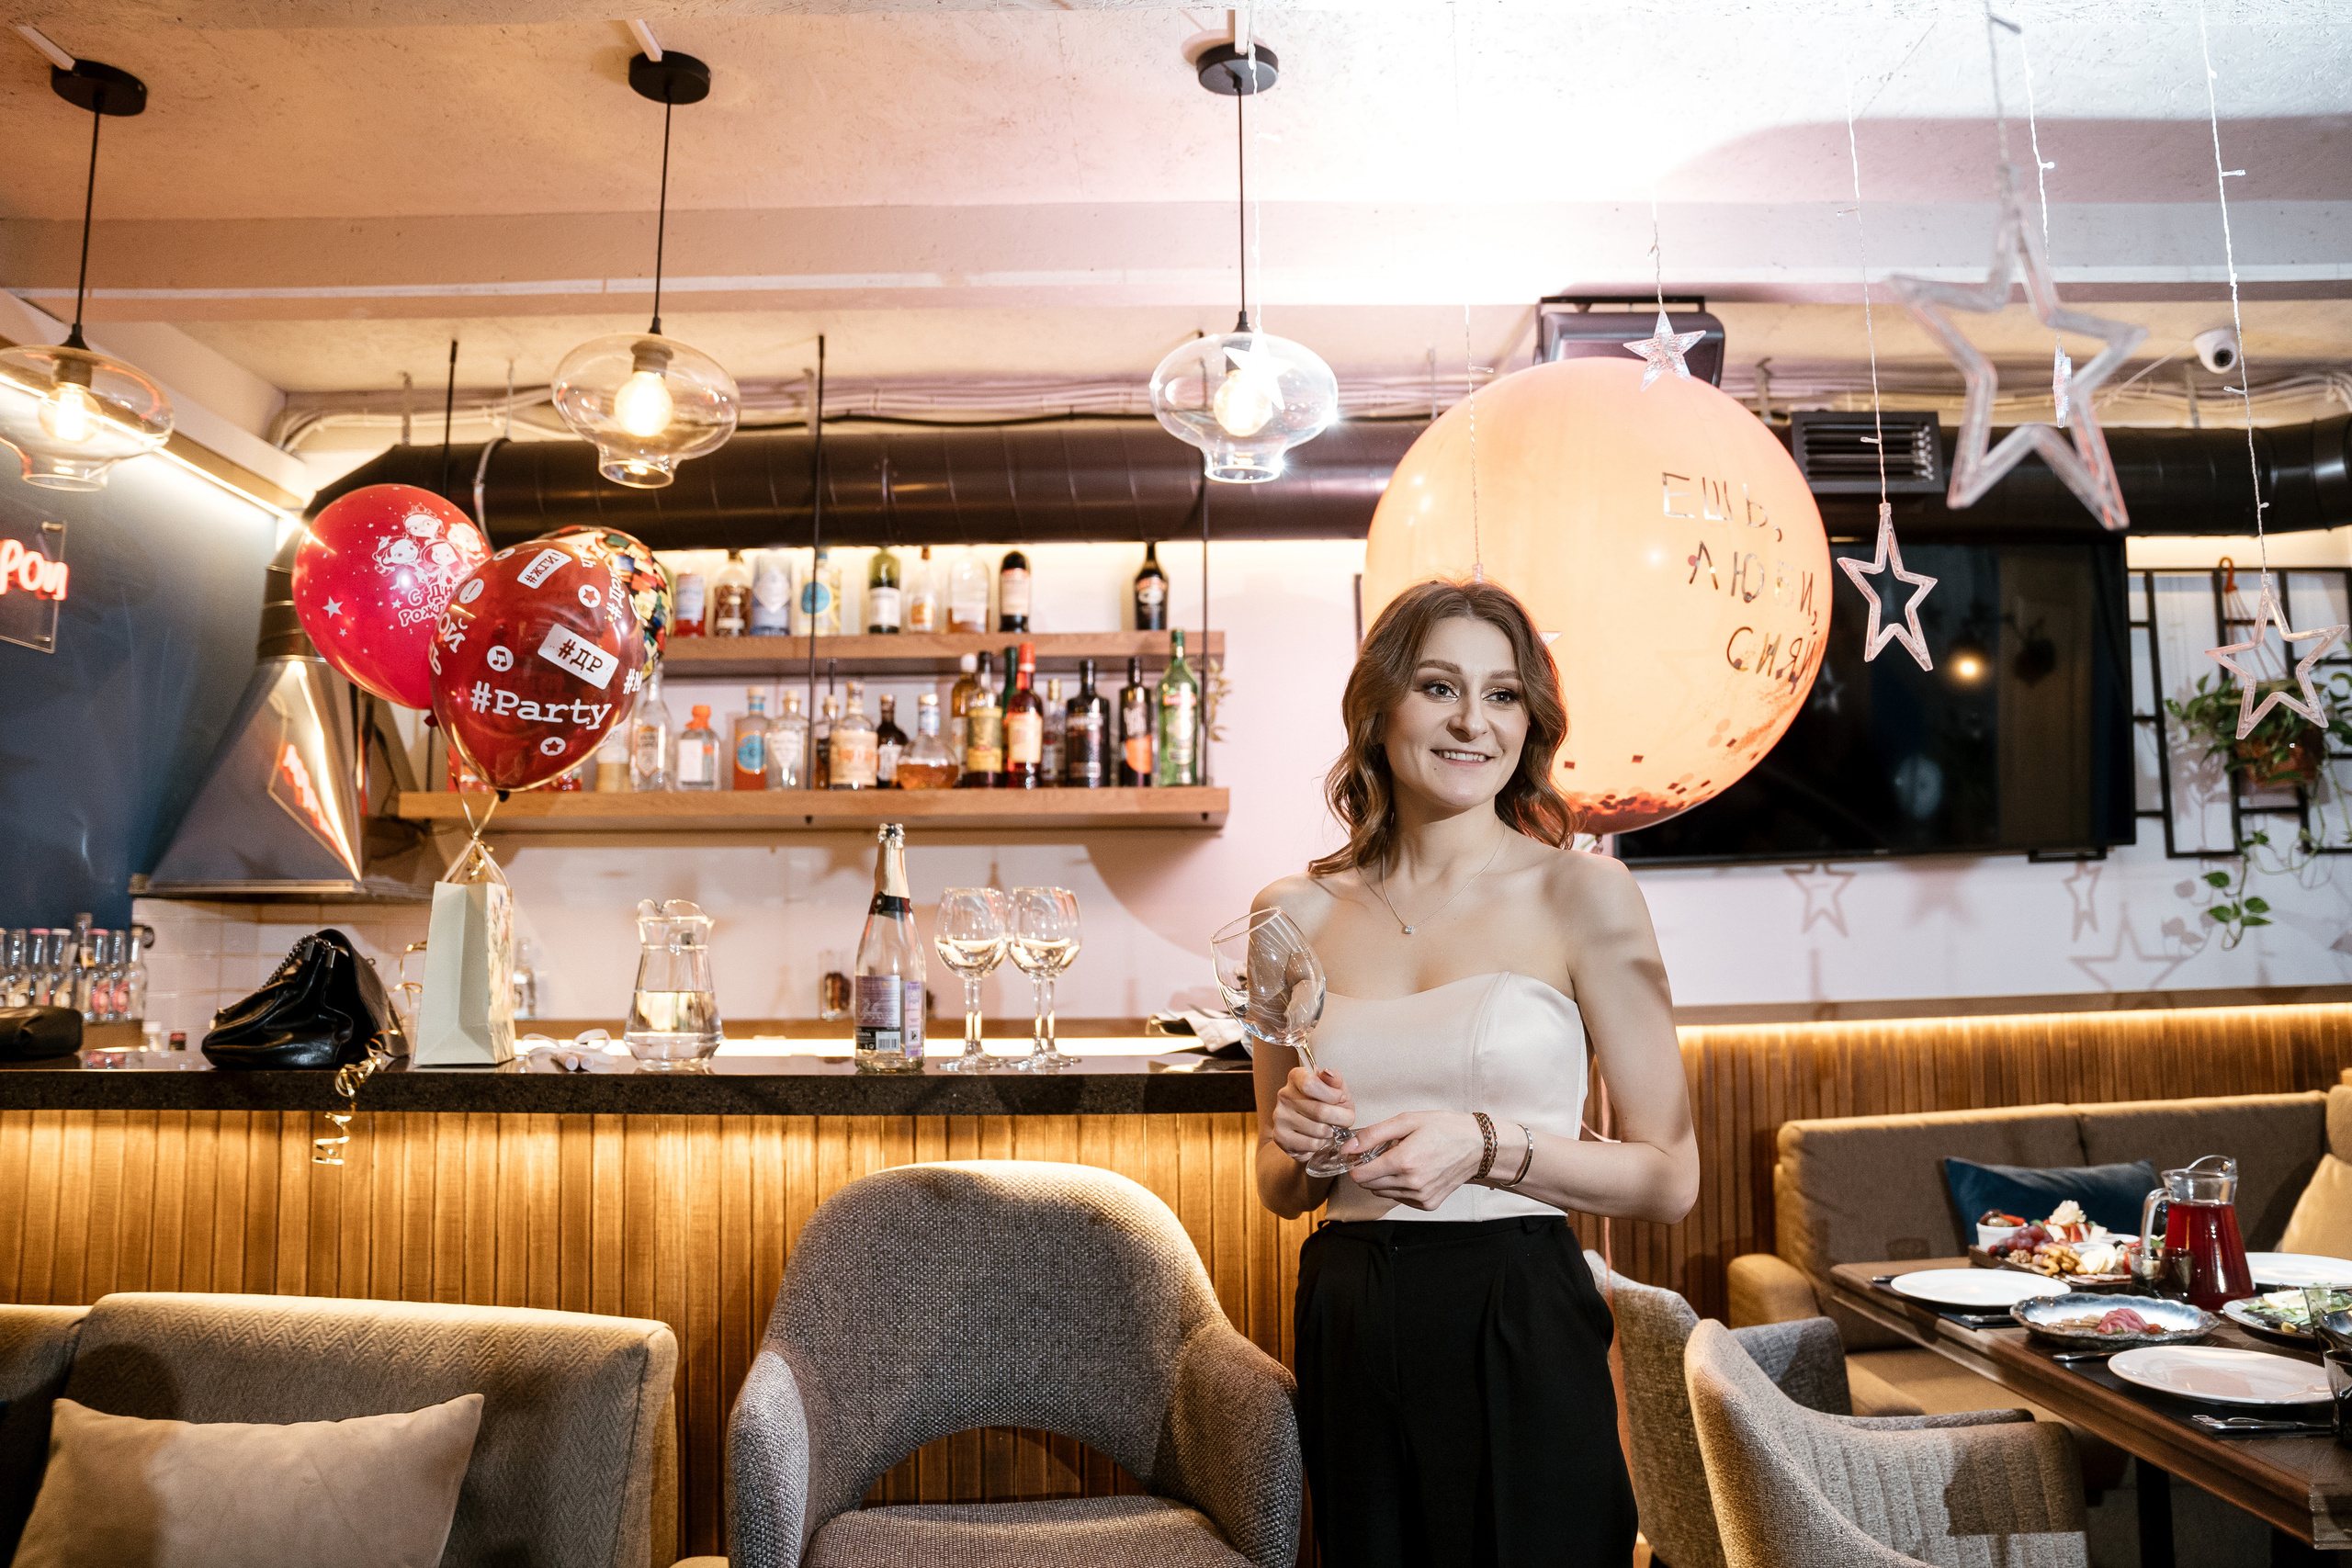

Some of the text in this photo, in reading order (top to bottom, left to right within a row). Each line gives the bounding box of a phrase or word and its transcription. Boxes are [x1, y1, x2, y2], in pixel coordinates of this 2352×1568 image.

[1661, 471, 1782, 542] ЕШЬ,
[1688, 540, 1818, 626] ЛЮБИ,
[557, 638, 604, 673] #ДР
[469, 681, 613, 730] #Party
